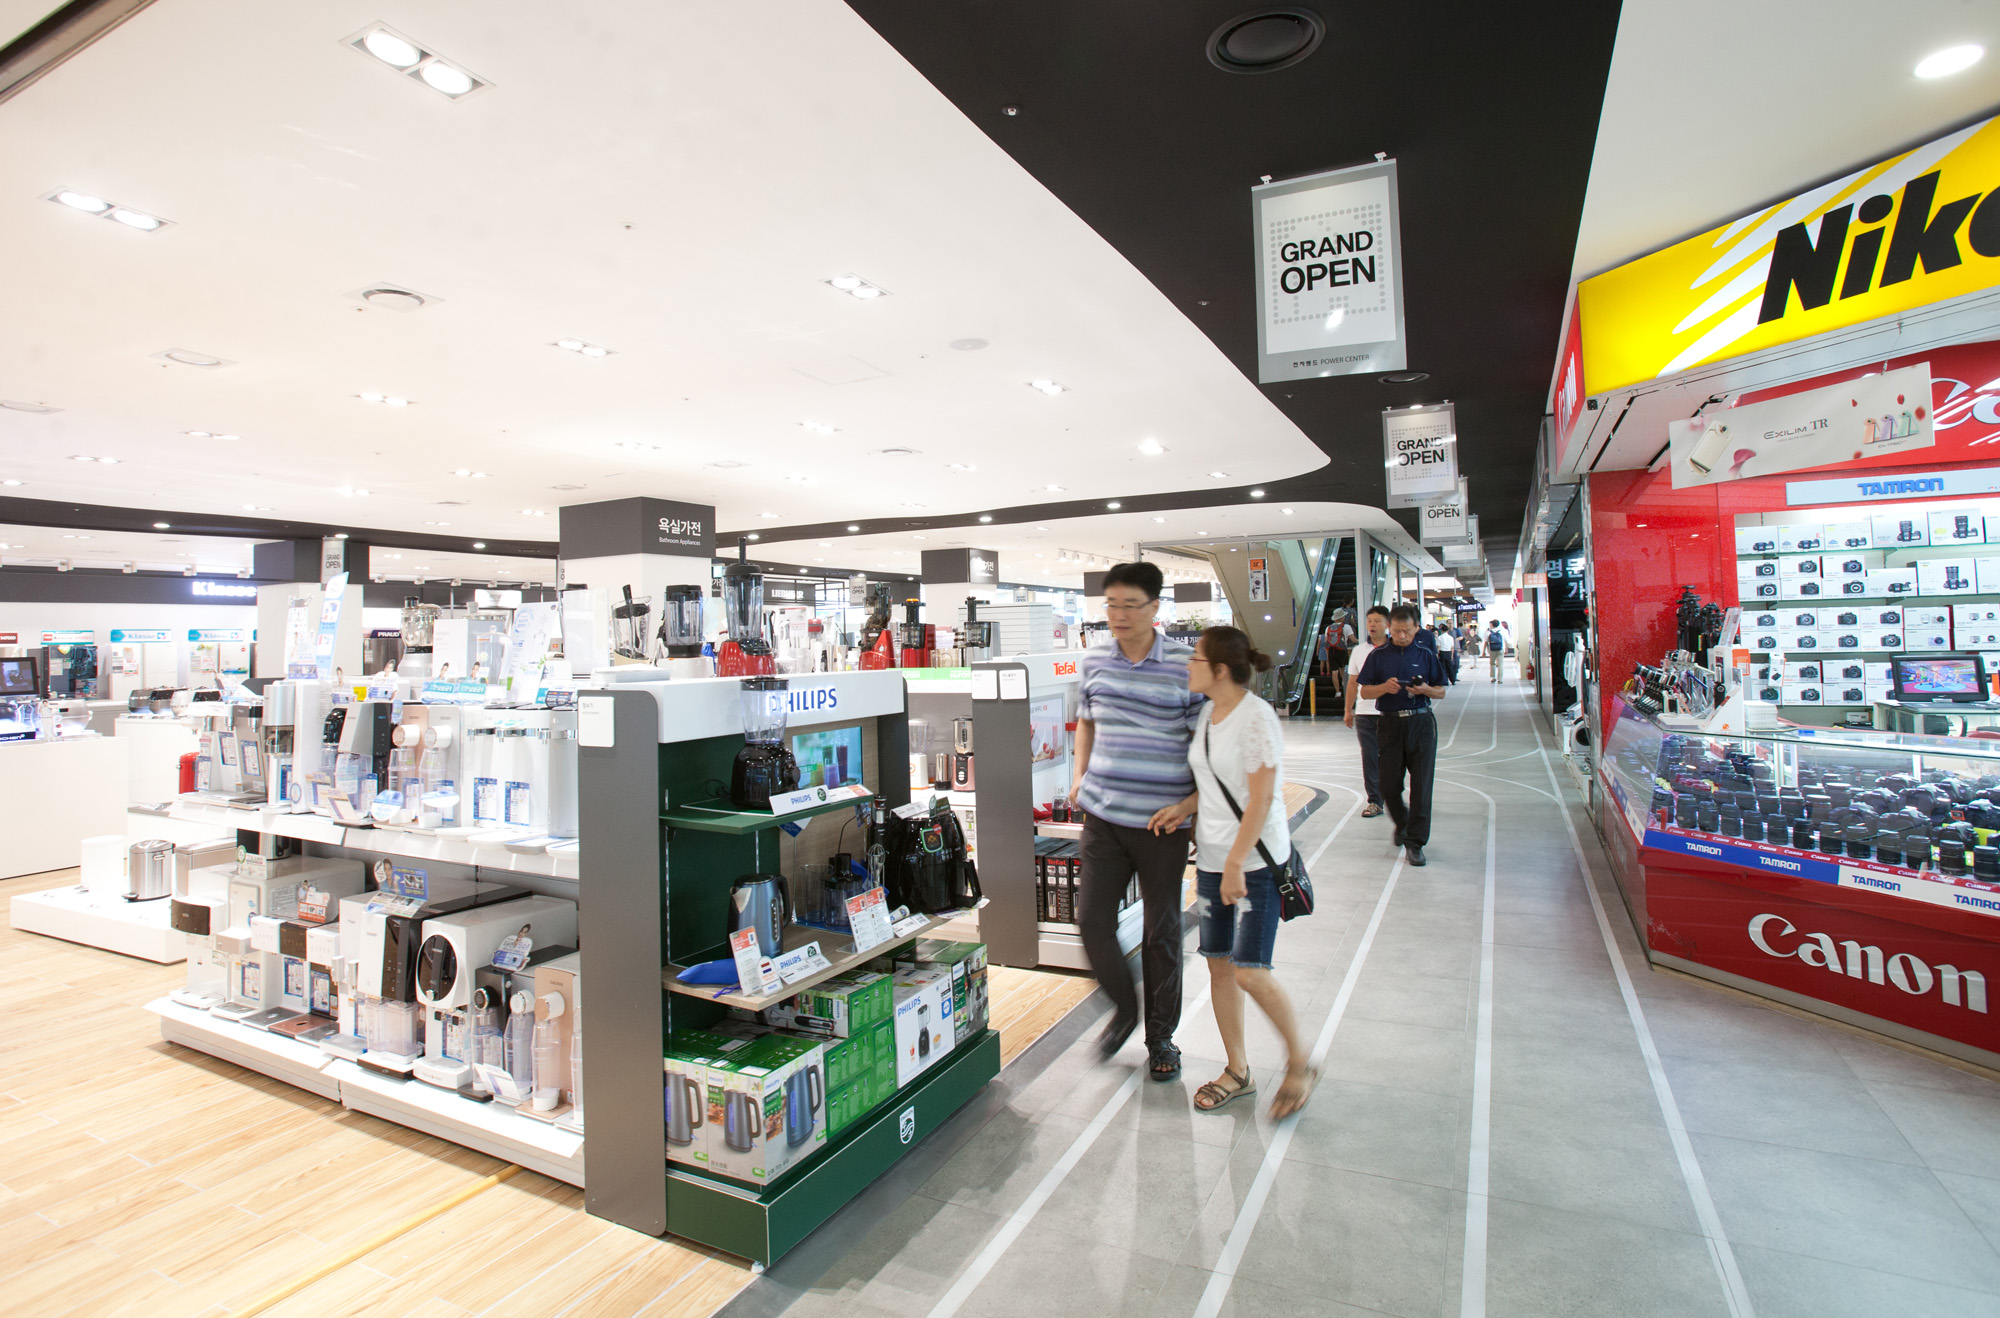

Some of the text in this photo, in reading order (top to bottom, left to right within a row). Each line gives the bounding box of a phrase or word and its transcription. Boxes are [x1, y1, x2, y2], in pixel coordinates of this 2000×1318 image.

[1281, 231, 1373, 263] GRAND
[1281, 255, 1375, 294] OPEN
[1320, 357, 1344, 365] POWER
[1345, 354, 1370, 363] CENTER
[1763, 425, 1807, 440] EXILIM
[1809, 418, 1829, 430] TR
[1398, 449, 1445, 466] OPEN
[1858, 478, 1944, 495] TAMRON
[1427, 508, 1460, 518] OPEN
[659, 518, 701, 536] 욕실가전
[680, 538, 701, 546] Appliances
[1053, 661, 1077, 676] Tefal
[767, 688, 837, 714] PHILIPS
[791, 794, 812, 805] PHILIPS
[1685, 842, 1722, 856] TAMRON
[1734, 840, 1752, 848] Canon
[1759, 856, 1801, 871] TAMRON
[1867, 864, 1890, 872] Canon
[1897, 869, 1921, 877] Canon
[1852, 875, 1901, 892] TAMRON
[1965, 882, 1992, 890] Canon
[780, 955, 801, 969] PHILIPS
[1748, 913, 1988, 1014] Canon
[898, 996, 921, 1017] PHILIPS
[765, 1079, 780, 1090] PHILIPS
